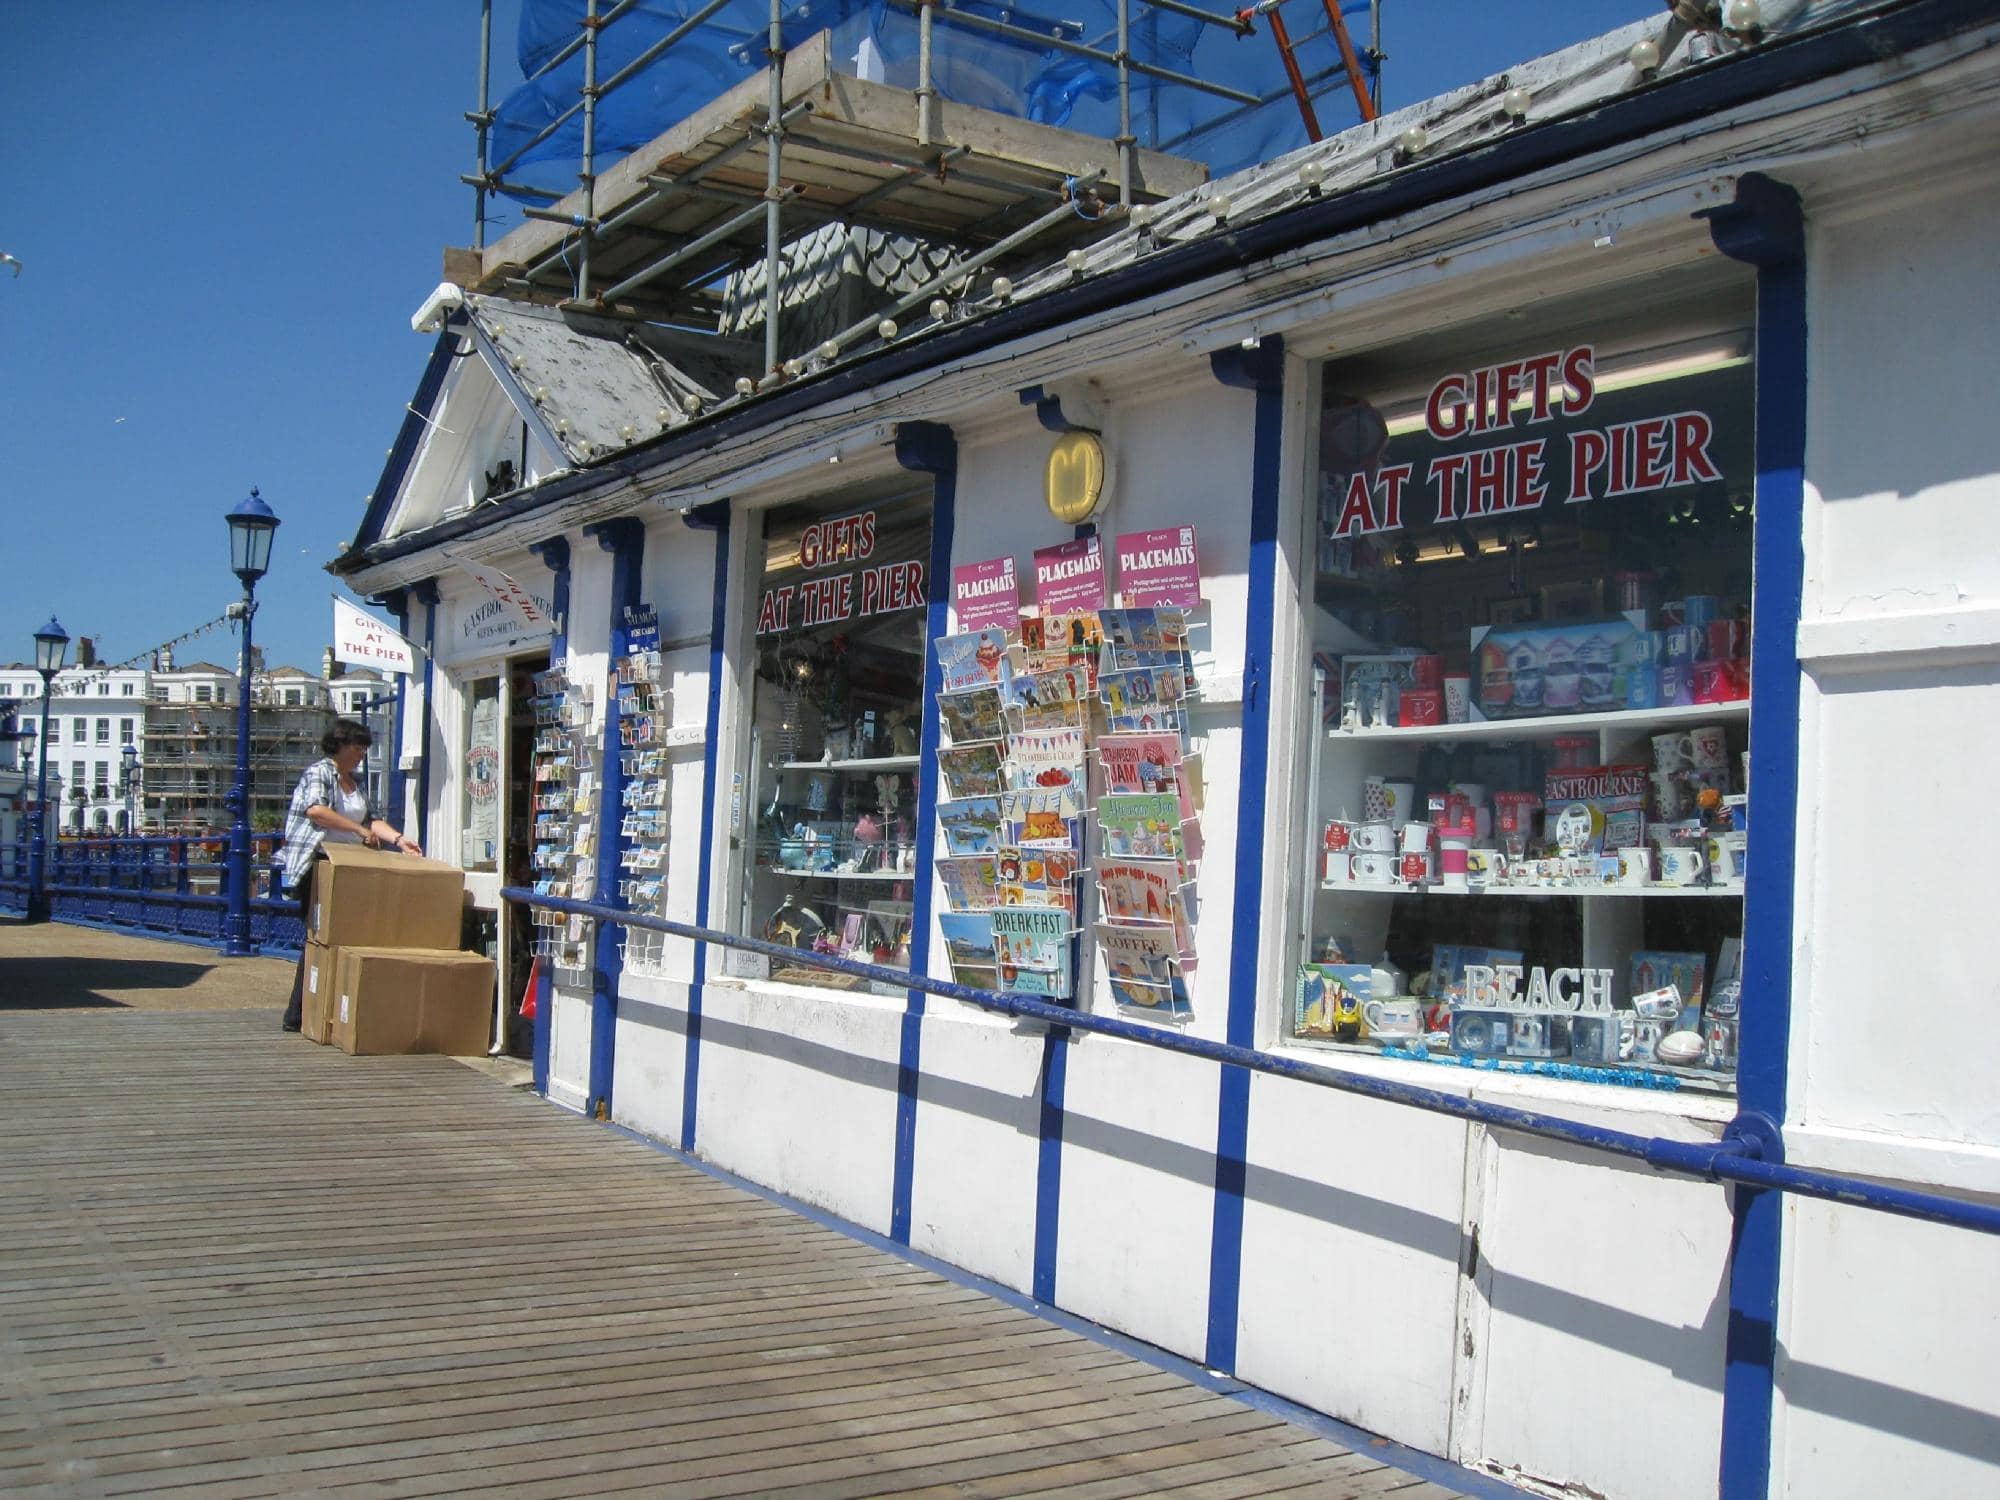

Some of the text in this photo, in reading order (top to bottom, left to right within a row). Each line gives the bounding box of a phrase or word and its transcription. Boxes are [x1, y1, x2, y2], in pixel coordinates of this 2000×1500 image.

[1425, 344, 1595, 441] GIFTS
[1331, 410, 1723, 539] AT THE PIER
[800, 511, 876, 570] GIFTS
[1038, 552, 1101, 584] PLACEMATS
[1121, 546, 1195, 572] PLACEMATS
[756, 560, 928, 635] AT THE PIER
[957, 573, 1015, 600] PLACEMATS
[366, 633, 383, 644] AT
[344, 642, 406, 662] THE PIER
[1102, 747, 1139, 762] STRAWBERRY
[1111, 764, 1138, 783] JAM
[994, 912, 1061, 934] BREAKFAST
[1106, 935, 1162, 951] COFFEE
[1464, 965, 1613, 1012] BEACH
